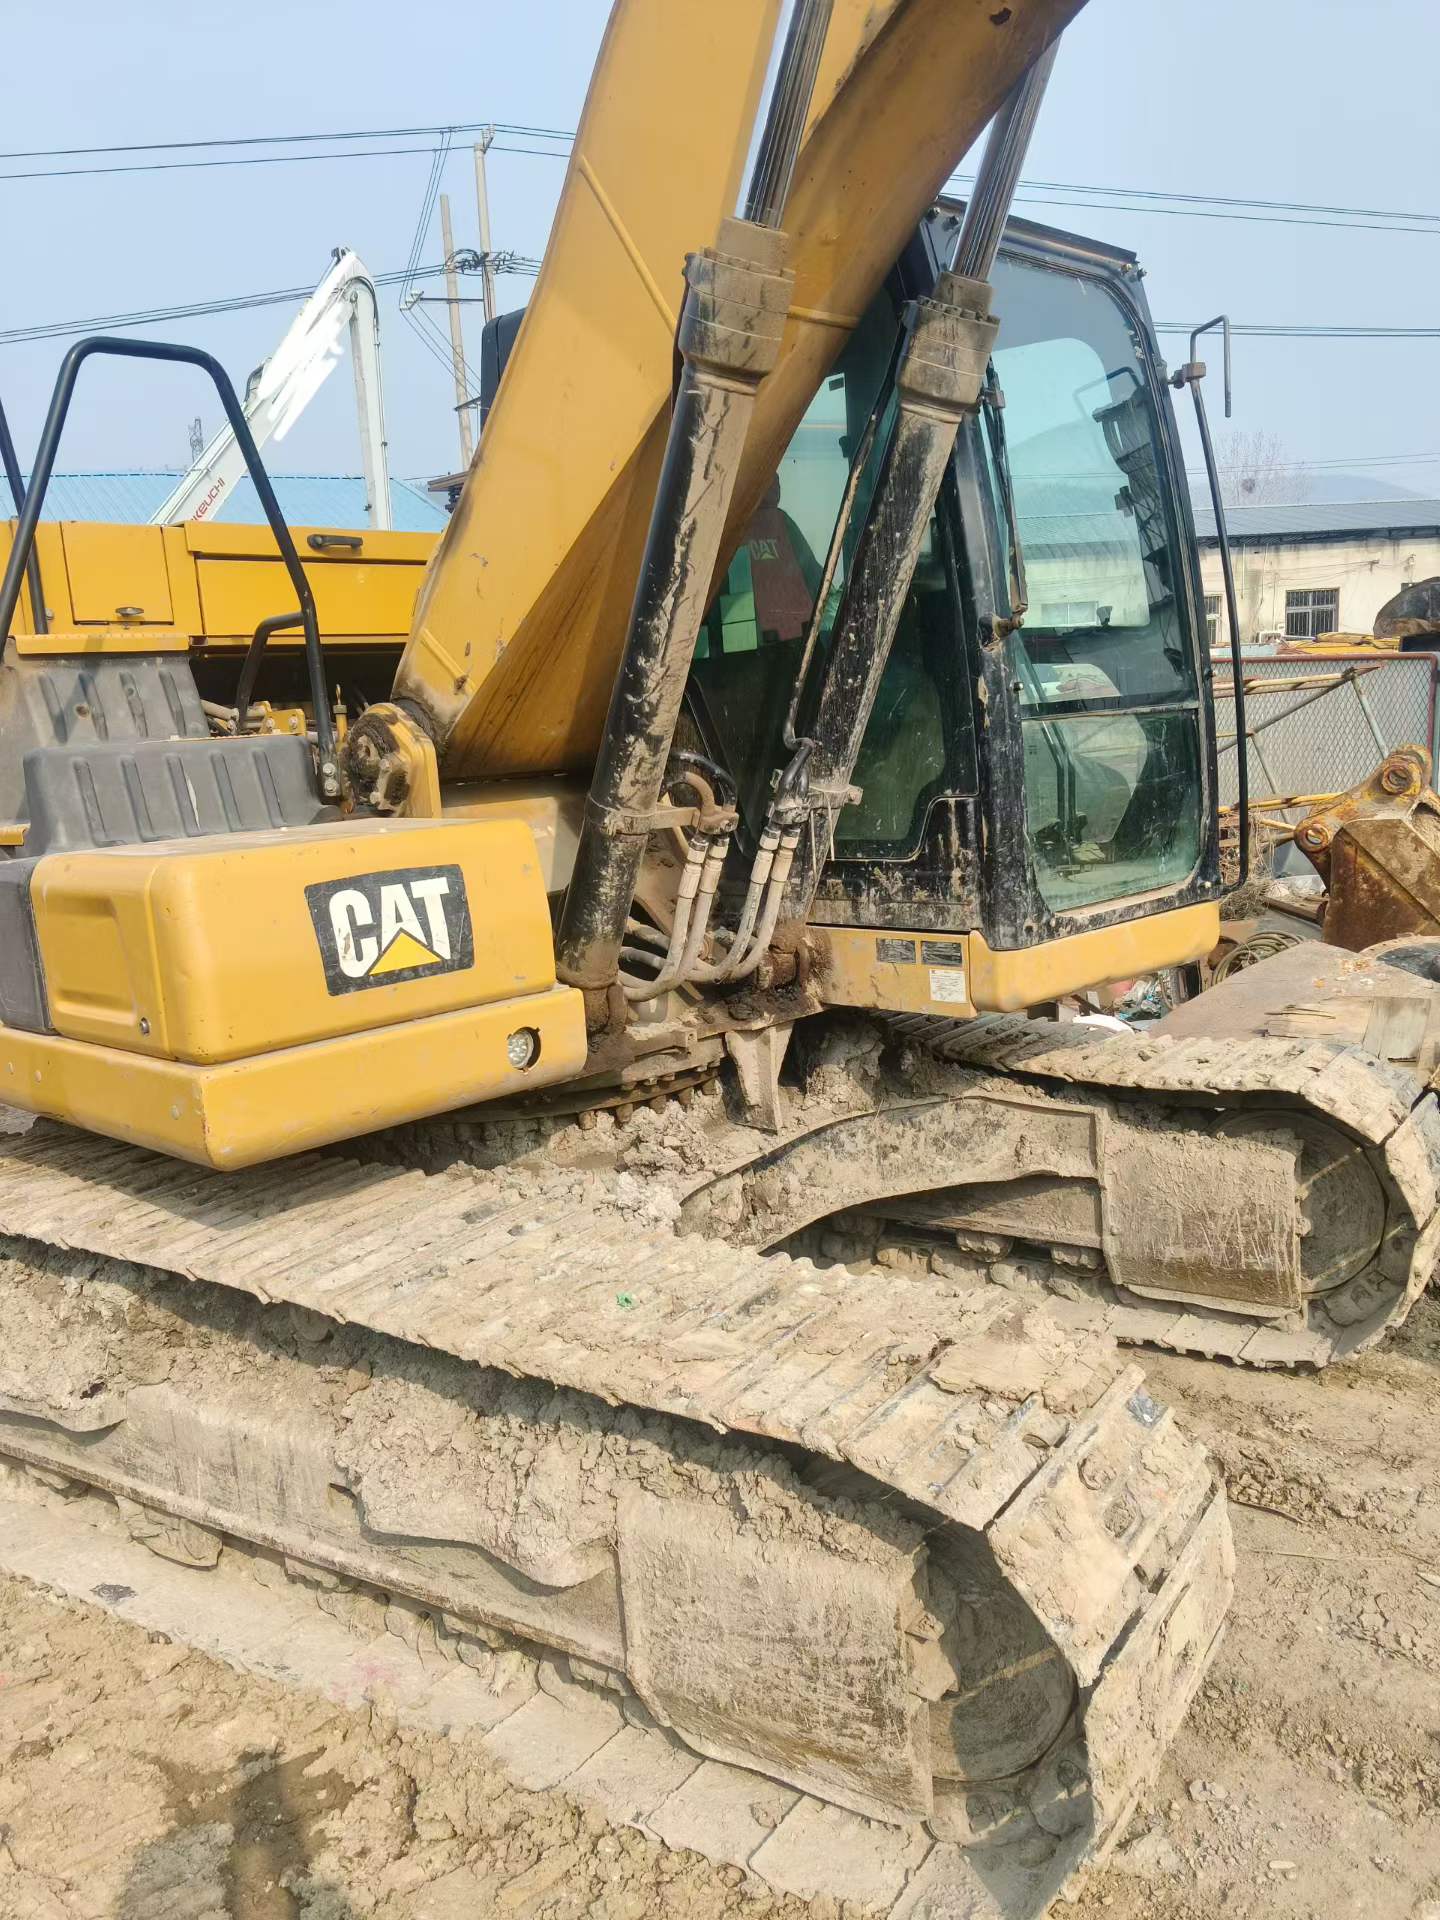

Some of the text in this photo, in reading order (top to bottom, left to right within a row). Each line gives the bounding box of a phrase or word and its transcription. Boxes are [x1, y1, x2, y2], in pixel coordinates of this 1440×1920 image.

[191, 477, 226, 521] KEUCHI
[750, 538, 780, 560] CAT
[328, 876, 451, 979] CAT
